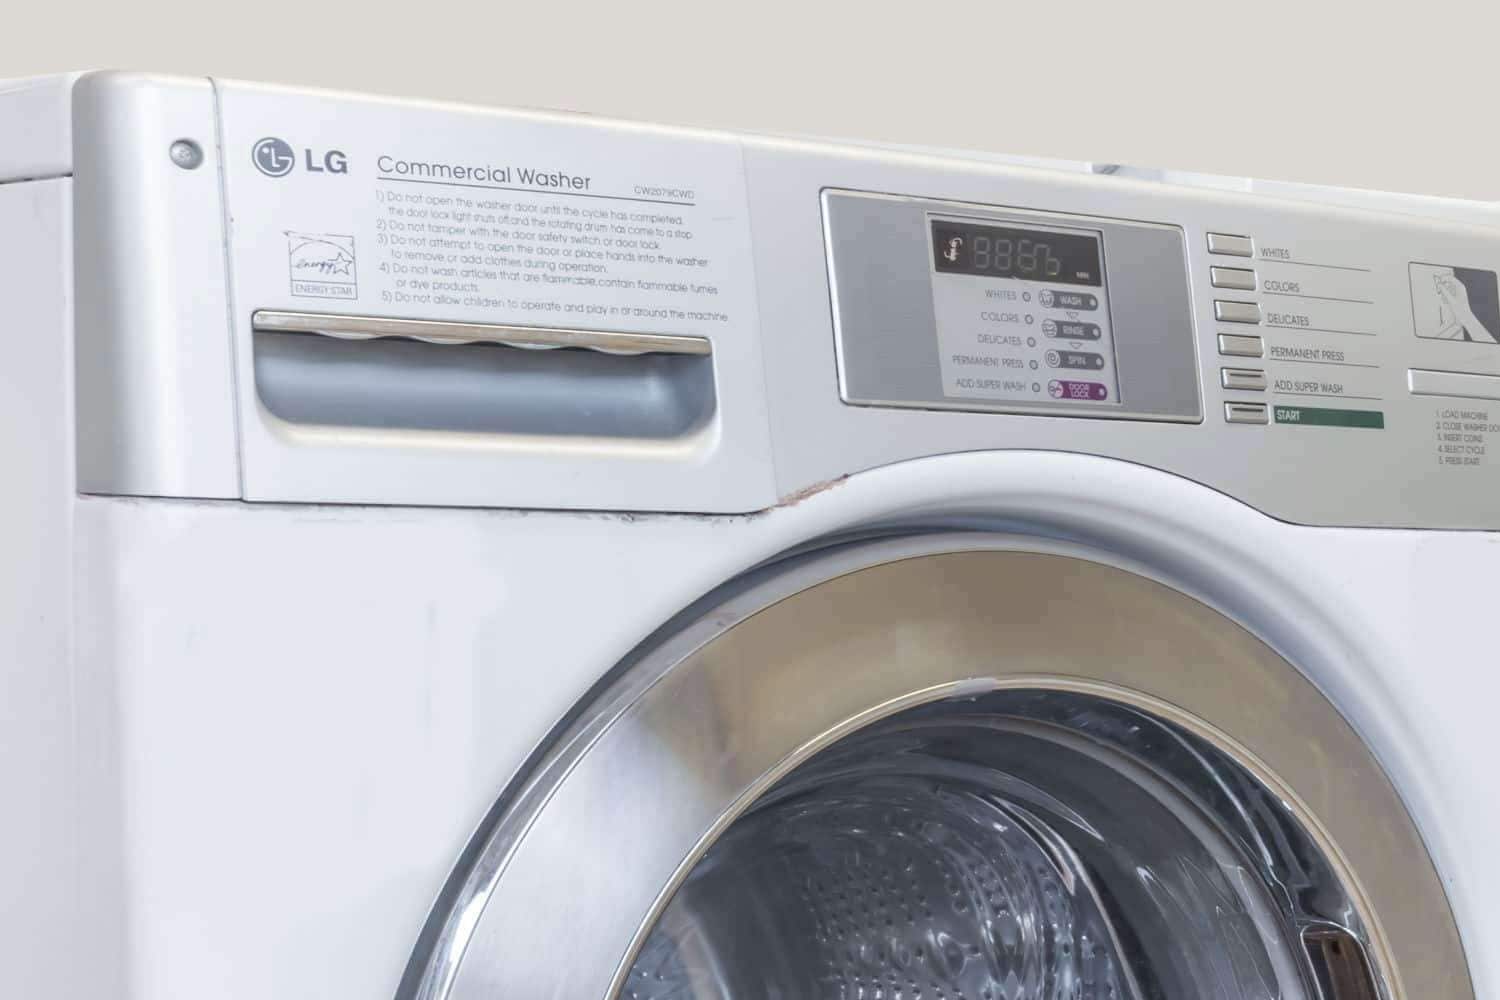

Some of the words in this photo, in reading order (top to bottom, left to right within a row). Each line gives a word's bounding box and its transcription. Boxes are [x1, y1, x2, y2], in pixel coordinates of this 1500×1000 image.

[305, 148, 348, 174] LG
[377, 155, 511, 183] Commercial
[516, 167, 591, 190] Washer
[387, 191, 402, 201] Do
[405, 193, 423, 203] not
[425, 194, 452, 207] open
[455, 197, 472, 207] the
[476, 198, 511, 211] washer
[514, 201, 536, 212] door
[540, 205, 561, 216] until
[563, 205, 578, 216] the
[582, 207, 607, 219] cycle
[610, 209, 626, 220] has
[388, 206, 403, 216] the
[406, 207, 427, 218] door
[431, 209, 448, 219] lock
[452, 211, 471, 223] light
[473, 213, 494, 223] shuts
[531, 217, 545, 226] the
[549, 219, 582, 232] rotating
[584, 221, 607, 233] drum
[611, 223, 624, 234] has
[628, 226, 653, 235] come
[655, 228, 664, 236] to
[389, 219, 403, 230] Do
[407, 221, 424, 232] not
[428, 222, 464, 236] tamper
[469, 225, 489, 236] with
[492, 227, 508, 238] the
[511, 229, 535, 240] door
[538, 232, 567, 245] safety
[570, 233, 600, 245] switch
[603, 238, 612, 246] or
[615, 236, 636, 248] door
[390, 234, 406, 245] Do
[408, 235, 425, 246] not
[429, 236, 470, 250] attempt
[473, 241, 483, 250] to
[487, 242, 514, 254] open
[517, 244, 533, 253] the
[537, 246, 560, 256] door
[562, 247, 572, 256] or
[575, 247, 603, 260] place
[606, 249, 635, 262] hands
[637, 253, 655, 263] into
[657, 254, 673, 265] the
[676, 256, 708, 268] washer
[1261, 247, 1290, 260] WHITES
[391, 248, 401, 258] to
[404, 250, 443, 261] remove
[447, 253, 456, 262] or
[460, 253, 481, 265] add
[485, 255, 520, 268] clothes
[525, 259, 556, 272] during
[392, 262, 407, 274] Do
[411, 264, 427, 273] not
[431, 265, 456, 276] wash
[460, 266, 496, 280] articles
[499, 269, 519, 281] that
[523, 272, 539, 282] are
[637, 279, 687, 294] flammable
[690, 284, 718, 296] fumes
[396, 279, 406, 287] or
[409, 278, 429, 290] dye
[1264, 279, 1300, 293] COLORS
[985, 288, 1017, 301] WHITES
[1060, 295, 1082, 306] WASH
[394, 291, 410, 303] Do
[413, 293, 430, 304] not
[433, 293, 459, 304] allow
[463, 294, 504, 309] children
[507, 299, 517, 309] to
[521, 301, 561, 313] operate
[563, 301, 583, 312] and
[586, 303, 607, 317] play
[610, 305, 618, 314] in
[621, 305, 632, 316] or
[633, 305, 667, 319] around
[669, 308, 684, 319] the
[687, 309, 727, 324] machine
[980, 311, 1019, 323] COLORS
[1267, 312, 1310, 327] DELICATES
[977, 334, 1022, 346] DELICATES
[1270, 346, 1320, 361] PERMANENT
[1322, 351, 1345, 362] PRESS
[952, 355, 999, 369] PERMANENT
[956, 378, 975, 389] ADD
[1002, 380, 1026, 392] WASH
[1069, 382, 1090, 391] DOOR
[1274, 380, 1293, 392] ADD
[1295, 382, 1319, 394] SUPER
[1321, 384, 1343, 395] WASH
[1071, 389, 1090, 398] LOCK
[1277, 410, 1300, 422] START
